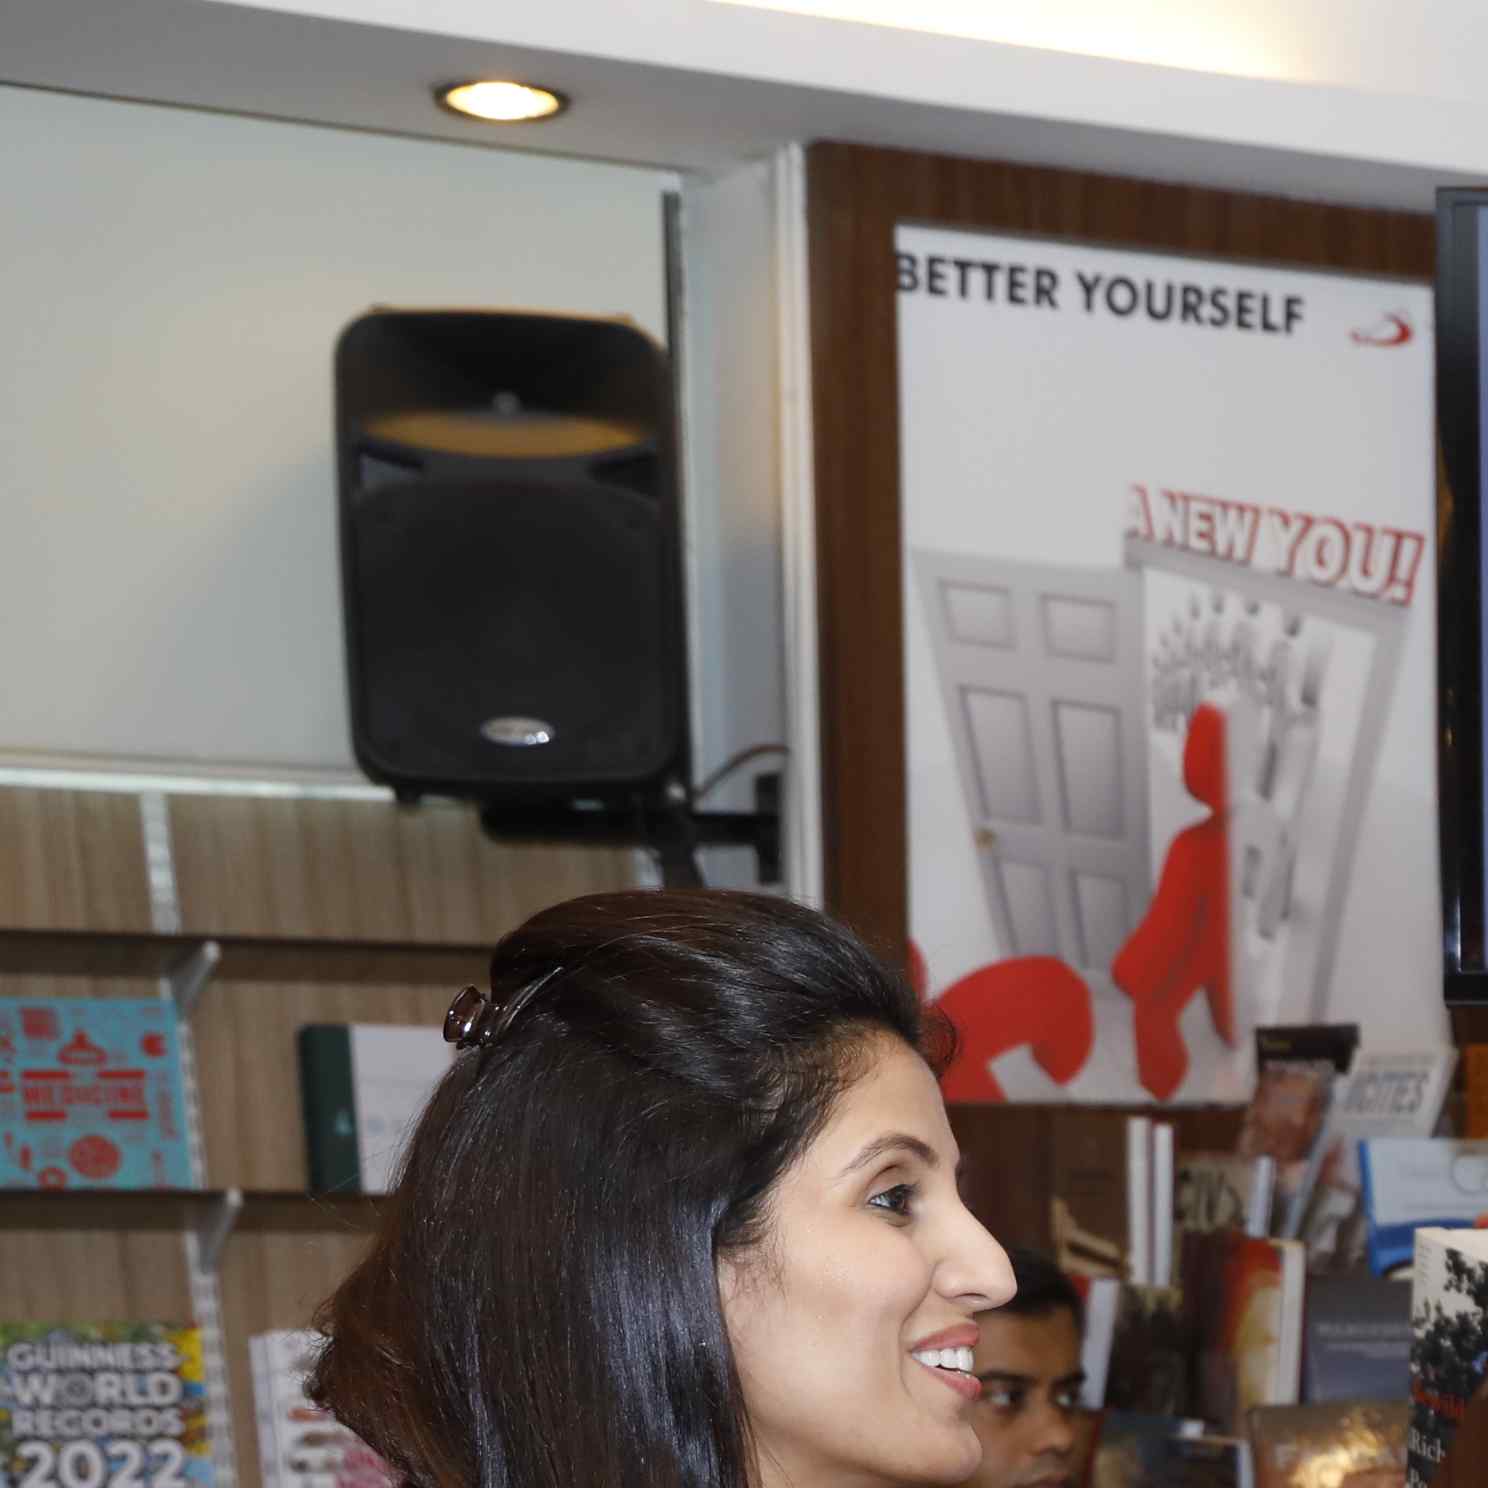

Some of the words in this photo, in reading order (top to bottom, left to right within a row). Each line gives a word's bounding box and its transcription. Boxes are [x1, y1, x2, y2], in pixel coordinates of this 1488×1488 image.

[896, 252, 1060, 309] BETTER
[1076, 270, 1304, 335] YOURSELF
[1158, 489, 1260, 565] NEW
[1262, 507, 1426, 608] YOU!
[8, 1344, 180, 1372] GUINNESS
[14, 1371, 184, 1405] WORLD
[12, 1406, 185, 1438] RECORDS
